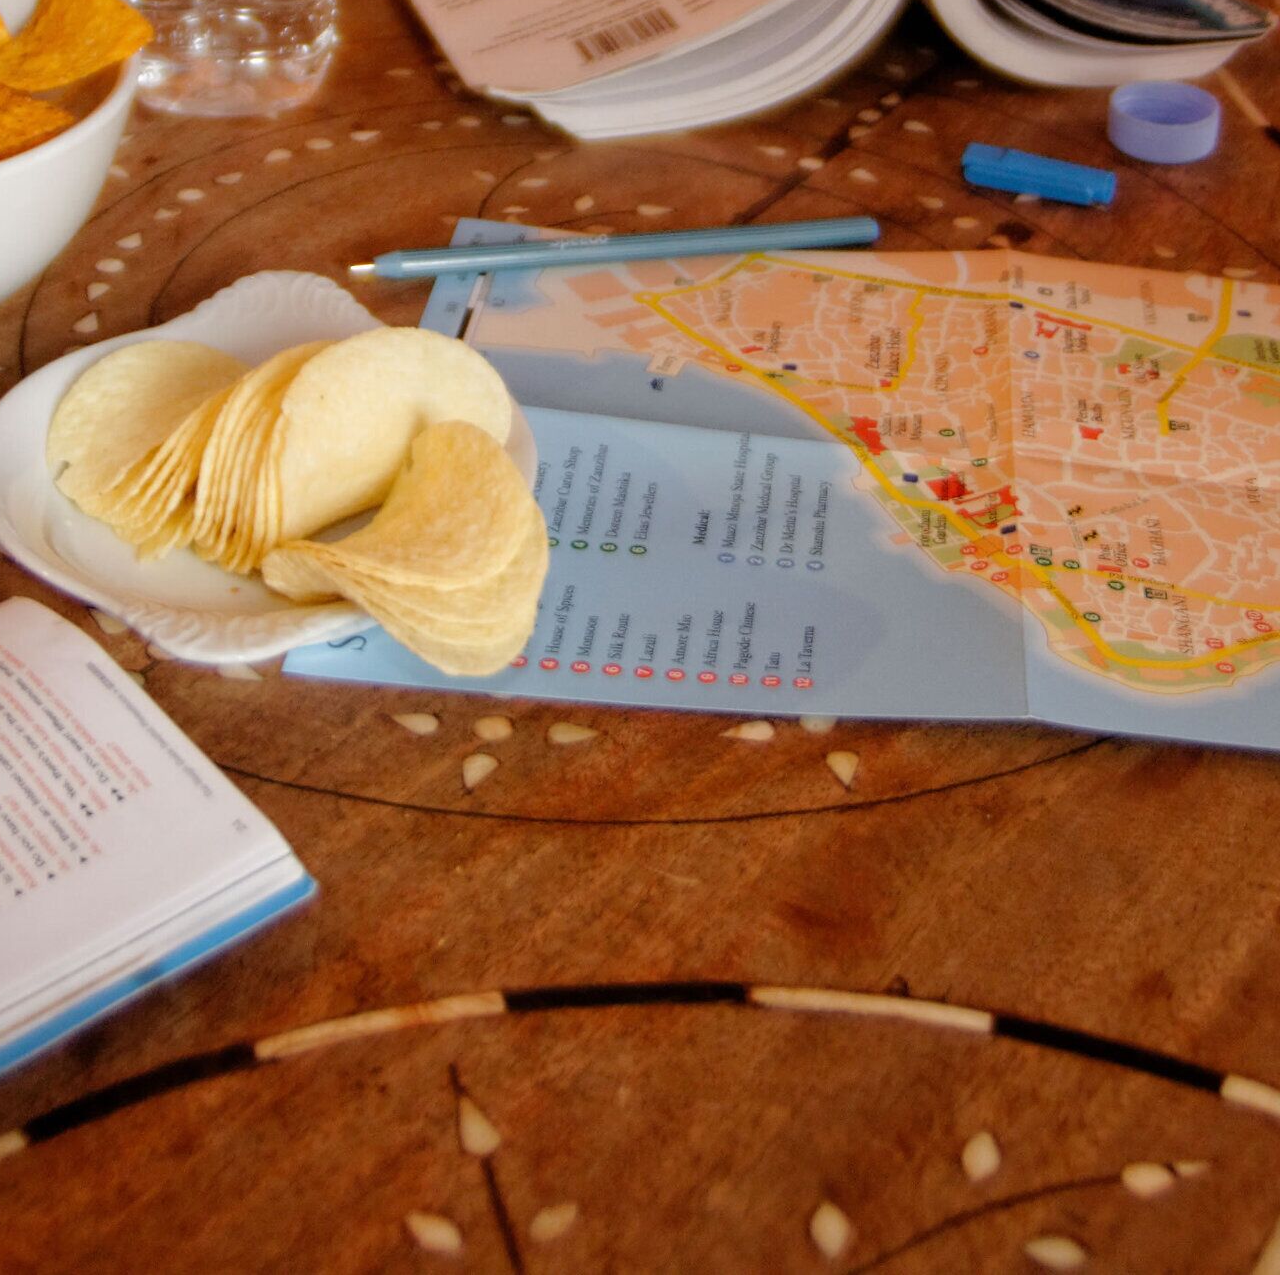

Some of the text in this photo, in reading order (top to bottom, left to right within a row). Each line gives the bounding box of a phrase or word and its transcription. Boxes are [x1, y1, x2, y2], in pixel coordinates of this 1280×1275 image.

[563, 447, 581, 469] Shop
[760, 453, 777, 481] Group
[588, 483, 600, 493] of
[730, 471, 744, 490] State
[786, 477, 802, 507] Hospital
[756, 483, 771, 513] Medical
[813, 482, 828, 519] Pharmacy
[693, 512, 709, 544] Medical:
[751, 517, 767, 550] Zanzibar
[1098, 543, 1110, 559] Post
[1114, 542, 1127, 566] Office
[556, 585, 574, 611] Spices
[554, 613, 567, 623] of
[612, 614, 629, 638] Route
[677, 615, 692, 631] Mio
[707, 611, 723, 636] House
[739, 603, 755, 635] Chinese
[1171, 594, 1193, 653] SHANGANI
[545, 625, 564, 653] House
[578, 616, 598, 655] Monsoon
[640, 634, 656, 661] Lazuli
[798, 626, 814, 657] Taverna
[608, 642, 624, 659] Silk
[672, 635, 688, 664] Amore
[704, 639, 719, 667] Africa
[734, 637, 752, 669] Pagode
[765, 652, 780, 670] Tatu
[797, 661, 811, 672] La
